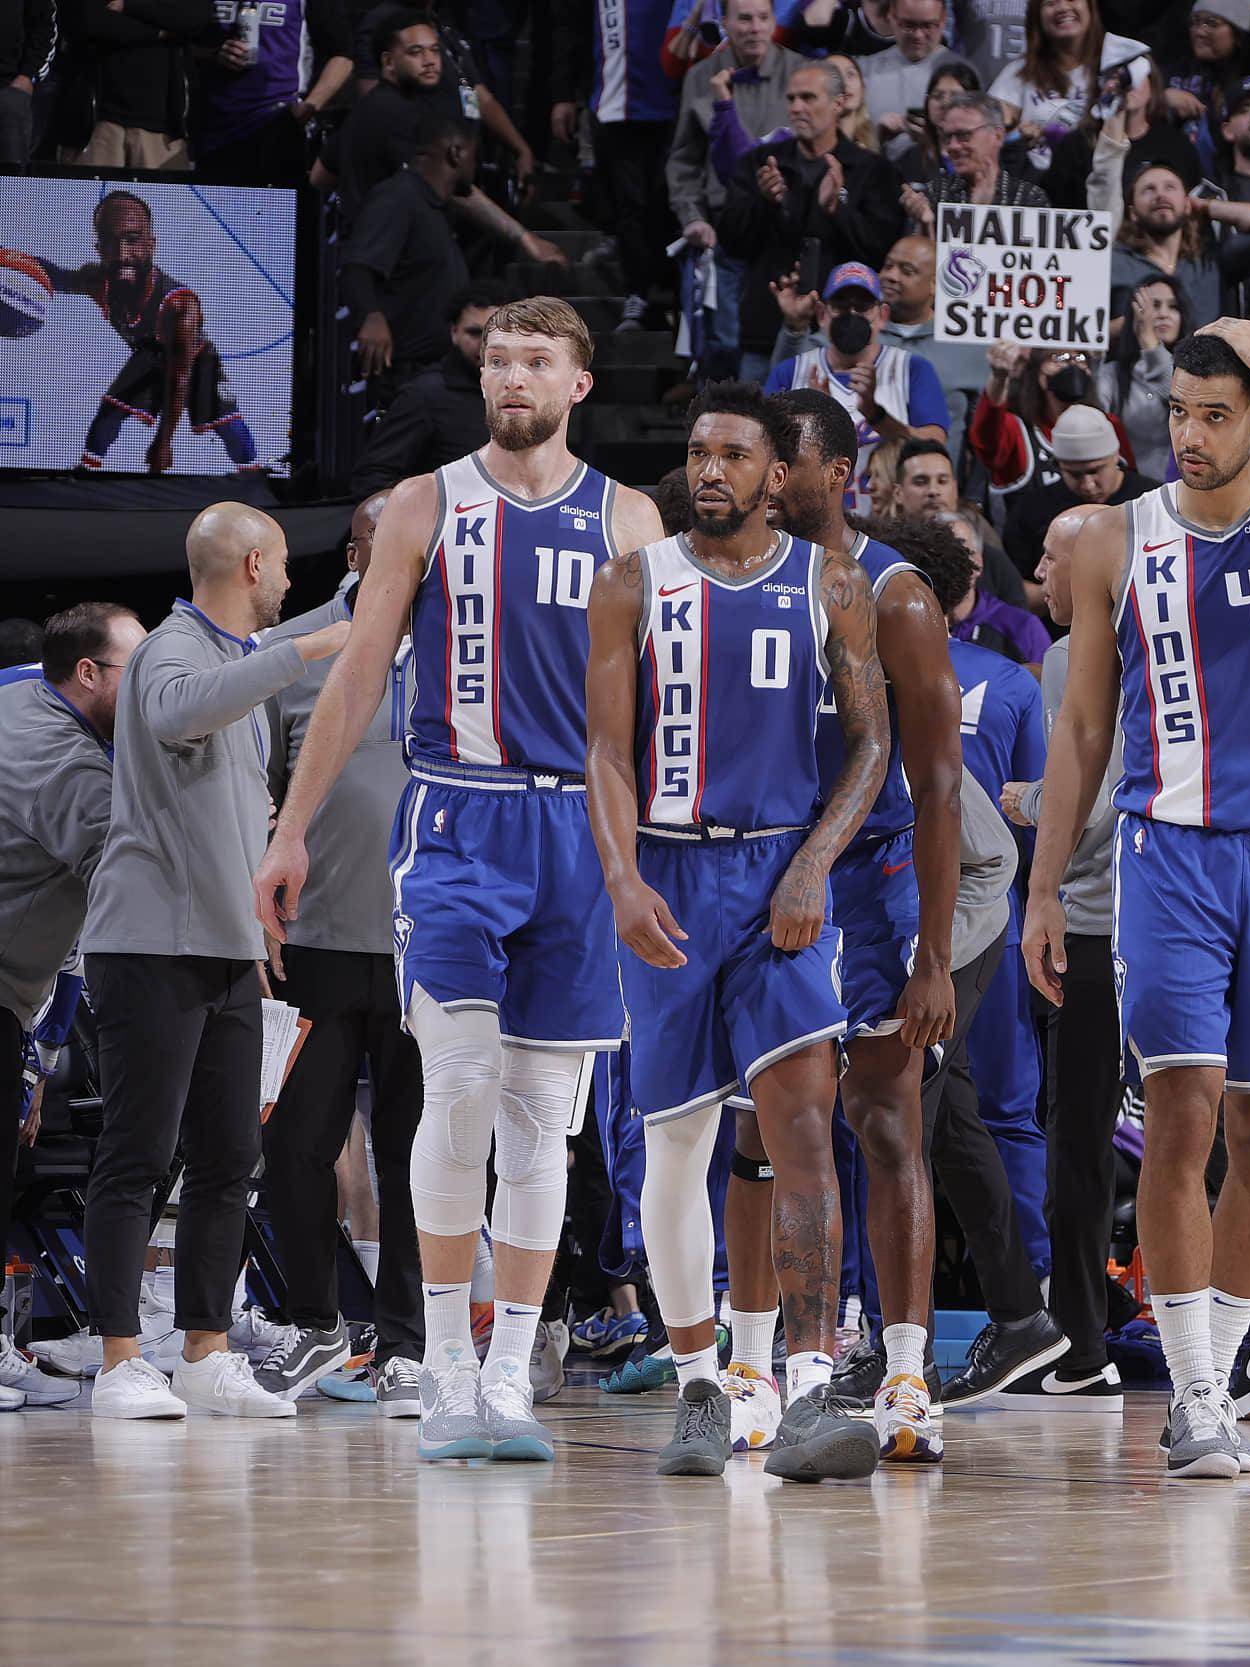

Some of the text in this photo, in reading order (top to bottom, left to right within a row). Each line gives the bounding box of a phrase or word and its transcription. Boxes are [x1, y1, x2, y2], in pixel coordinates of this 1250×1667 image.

[941, 206, 1109, 250] MALIK's
[1002, 252, 1060, 271] ON A
[987, 272, 1072, 310] HOT
[944, 300, 1106, 344] Streak!
[560, 504, 600, 520] dialpad
[534, 546, 595, 610] 10
[762, 582, 806, 596] dialpad
[750, 628, 791, 689] 0
